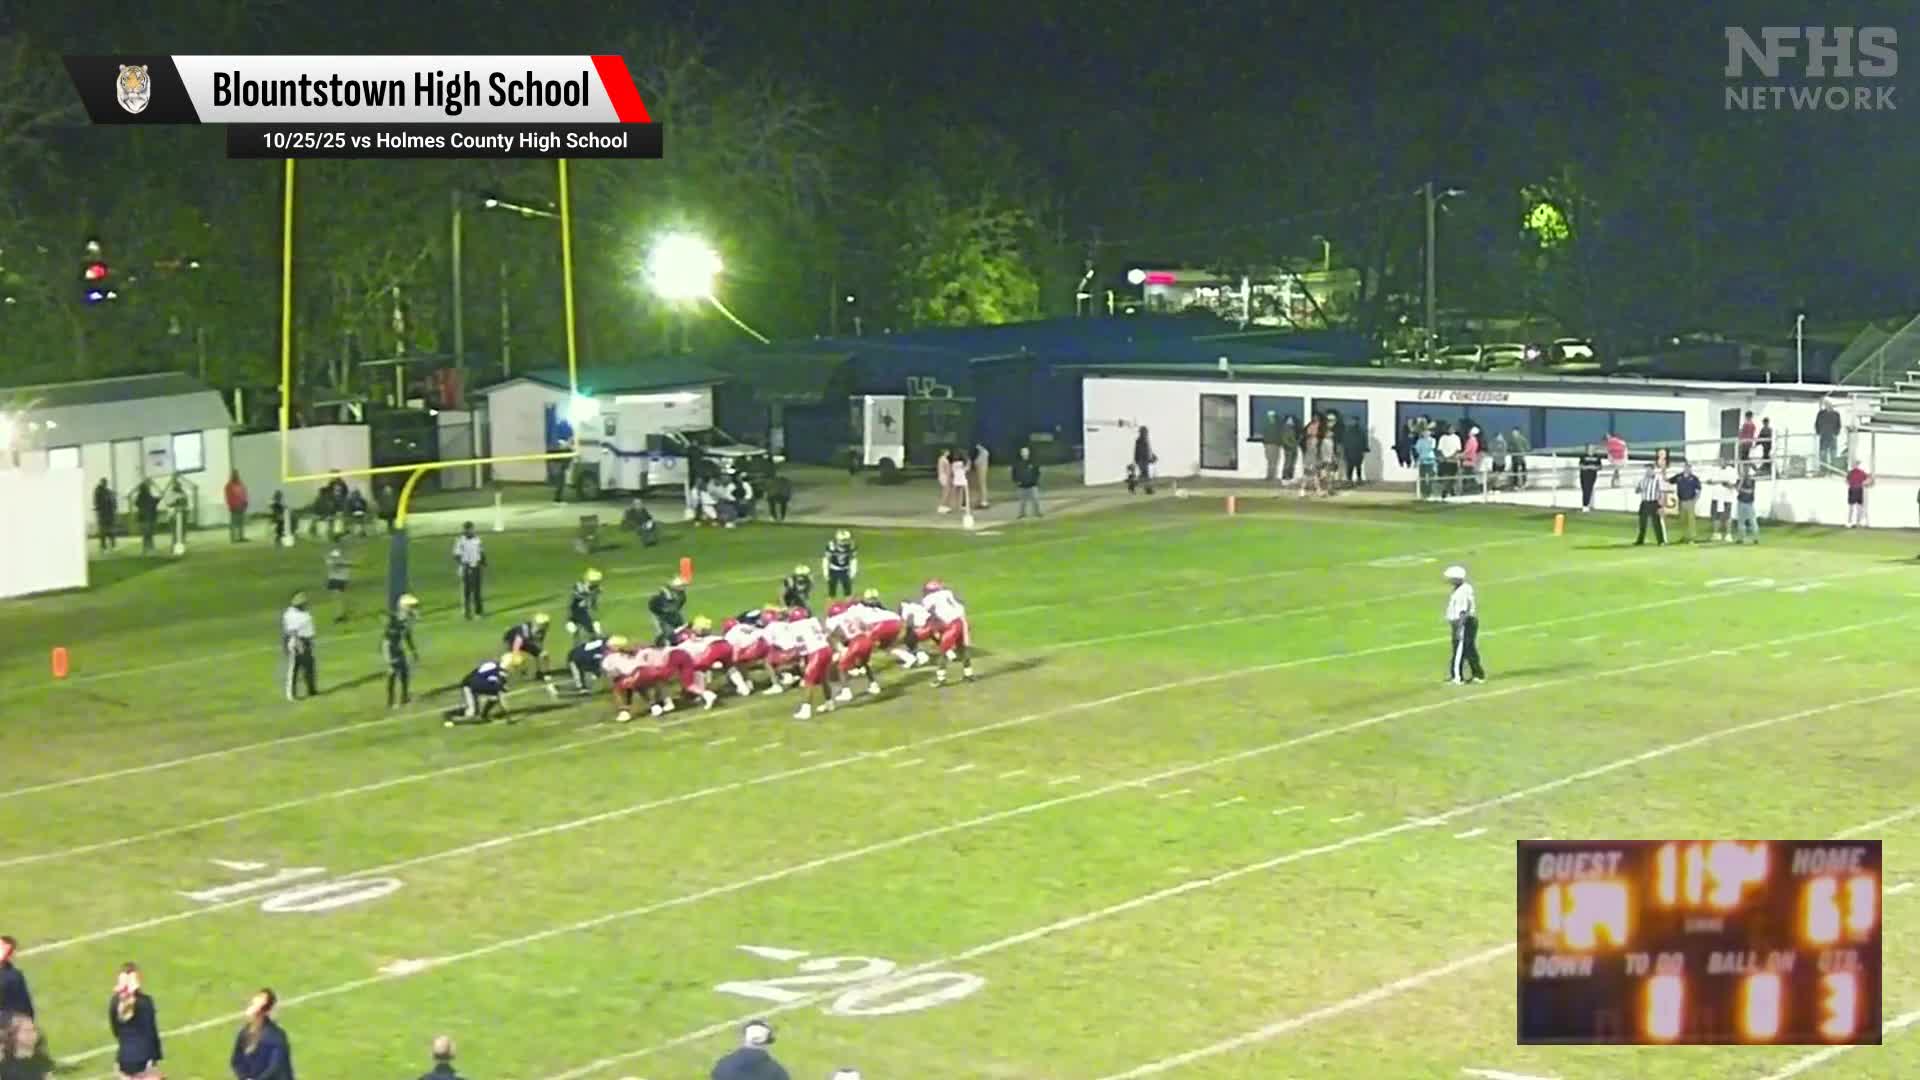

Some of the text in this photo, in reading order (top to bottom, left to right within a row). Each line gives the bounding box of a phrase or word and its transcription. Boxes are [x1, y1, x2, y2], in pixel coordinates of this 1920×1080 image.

[1537, 851, 1623, 881] GUEST
[1792, 848, 1866, 876] HOME
[1532, 955, 1594, 977] DOWN
[1625, 953, 1650, 976] TO
[713, 956, 986, 1016] 20
